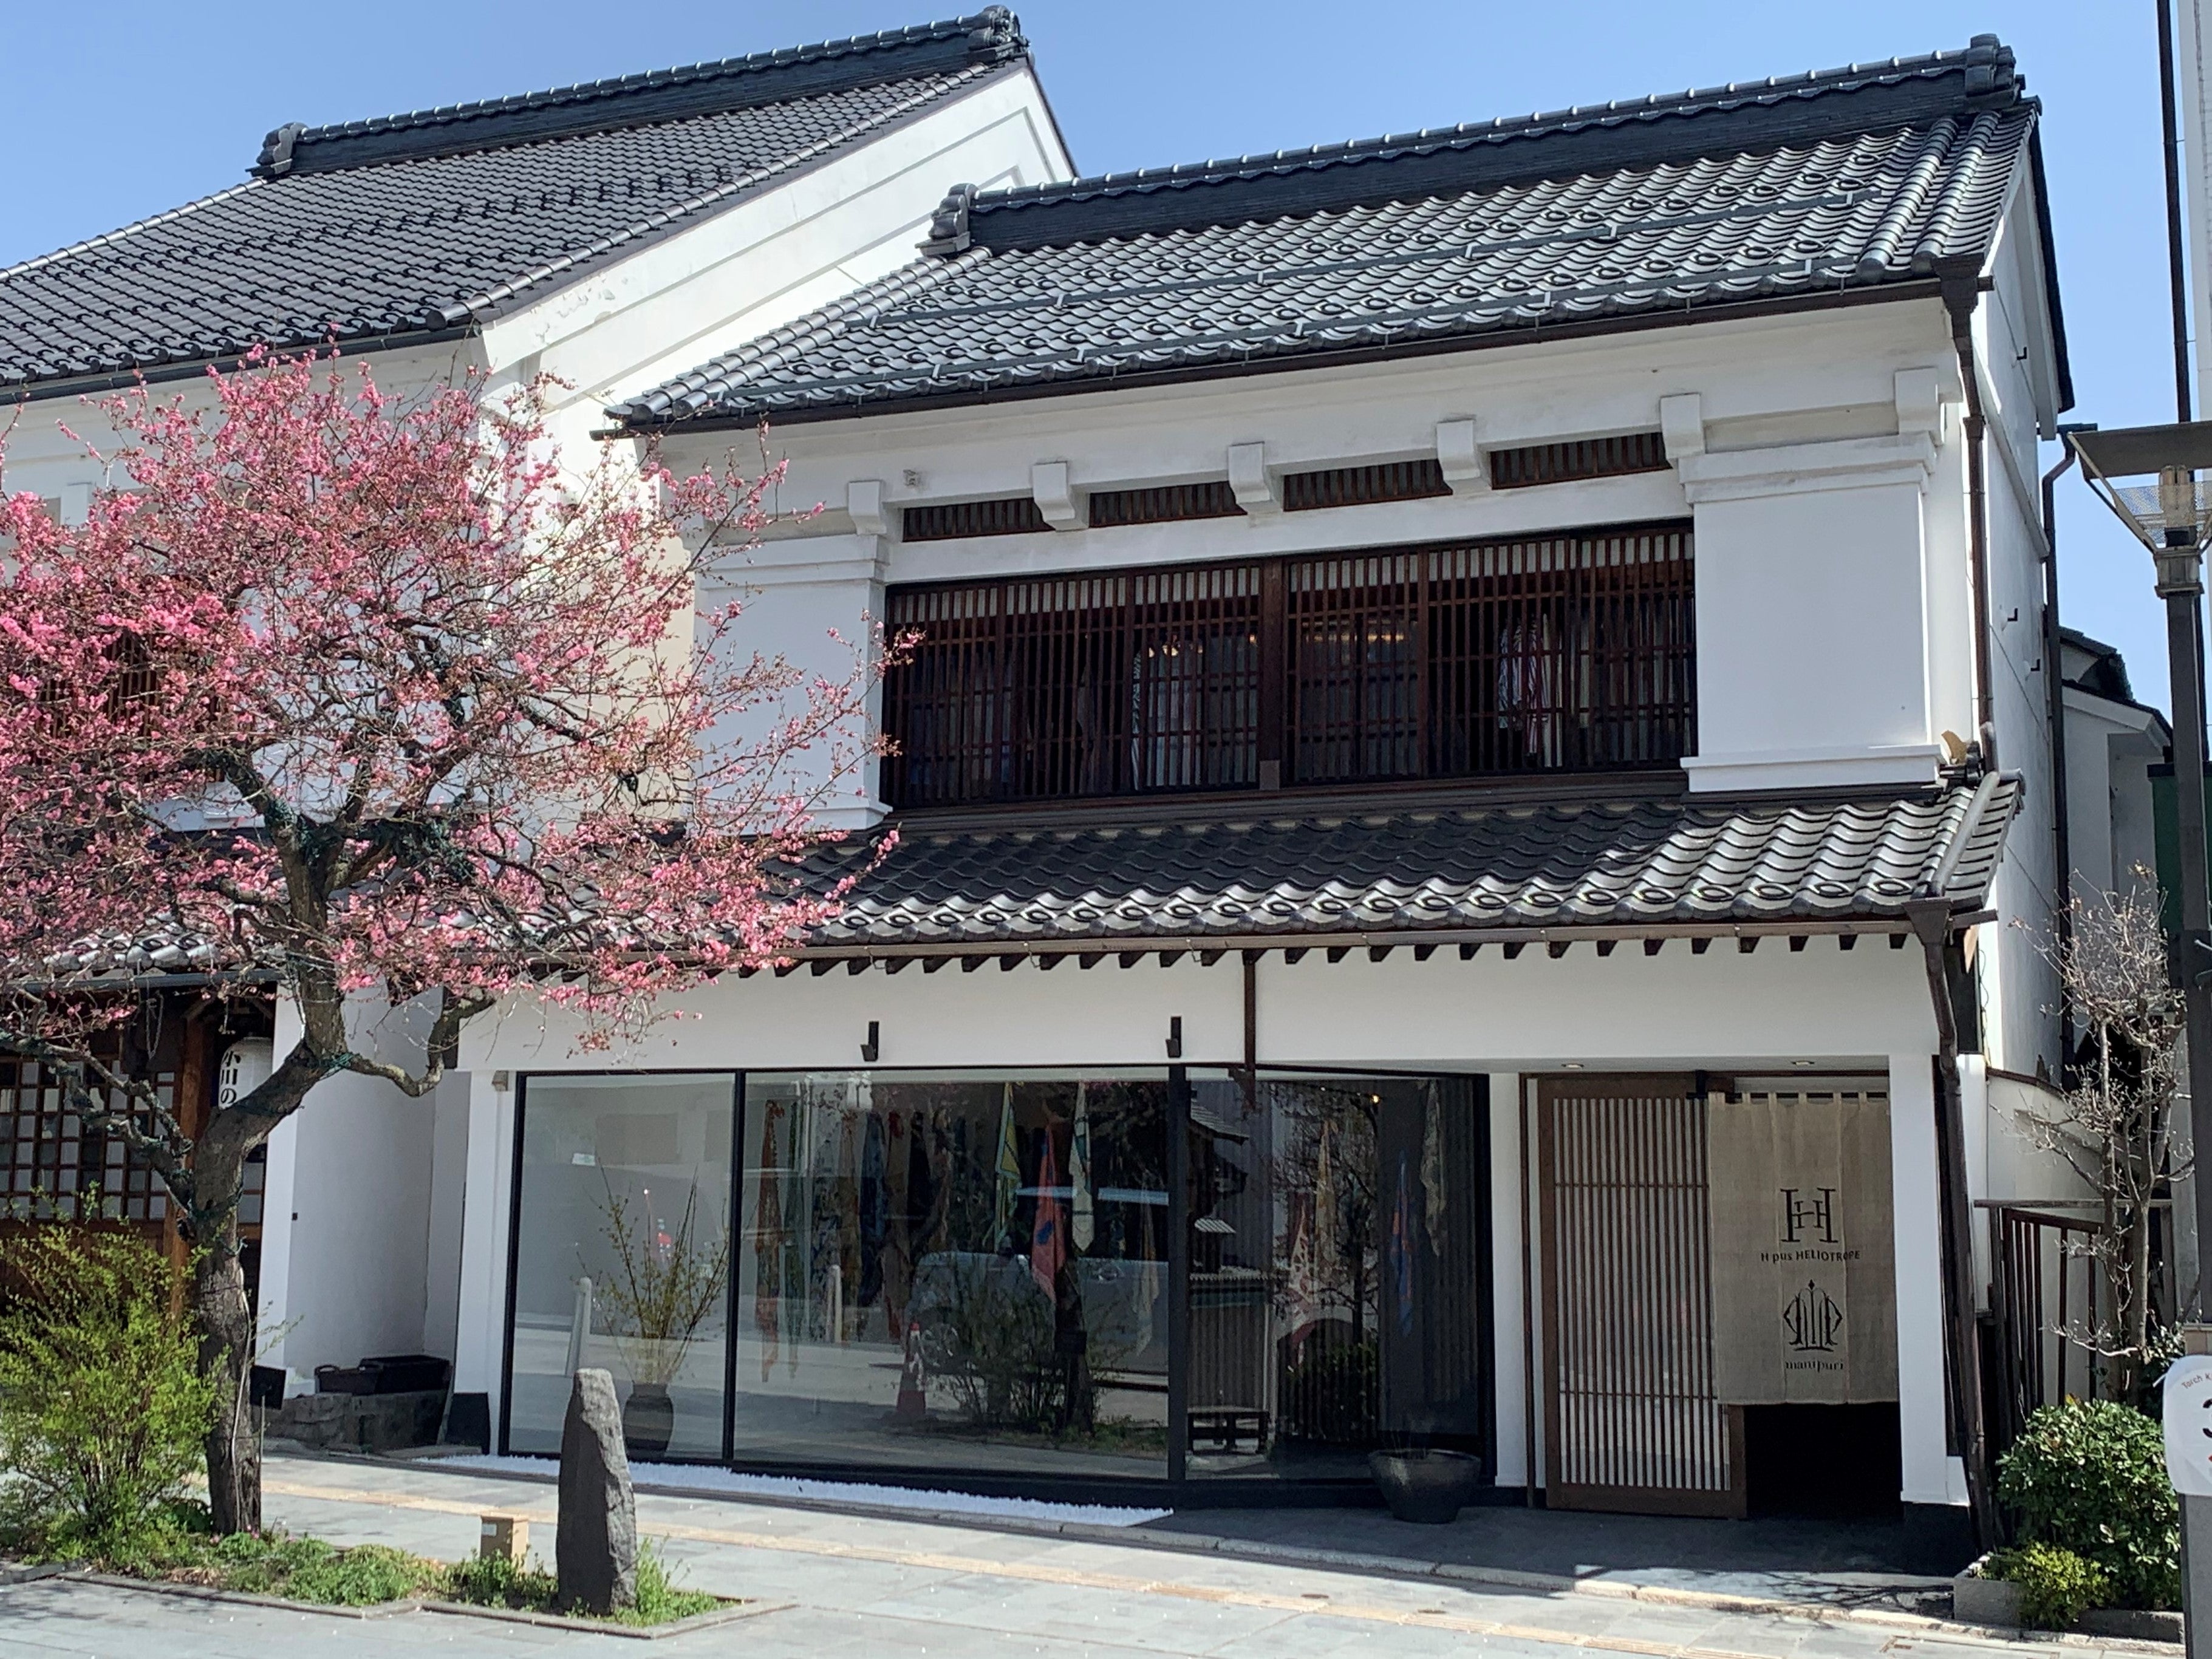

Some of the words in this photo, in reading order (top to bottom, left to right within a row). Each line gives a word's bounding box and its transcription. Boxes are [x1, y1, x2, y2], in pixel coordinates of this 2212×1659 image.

[219, 1050, 241, 1105] 小川の
[1795, 1249, 1860, 1262] HELIOTROPE
[1786, 1358, 1844, 1373] manipuri
